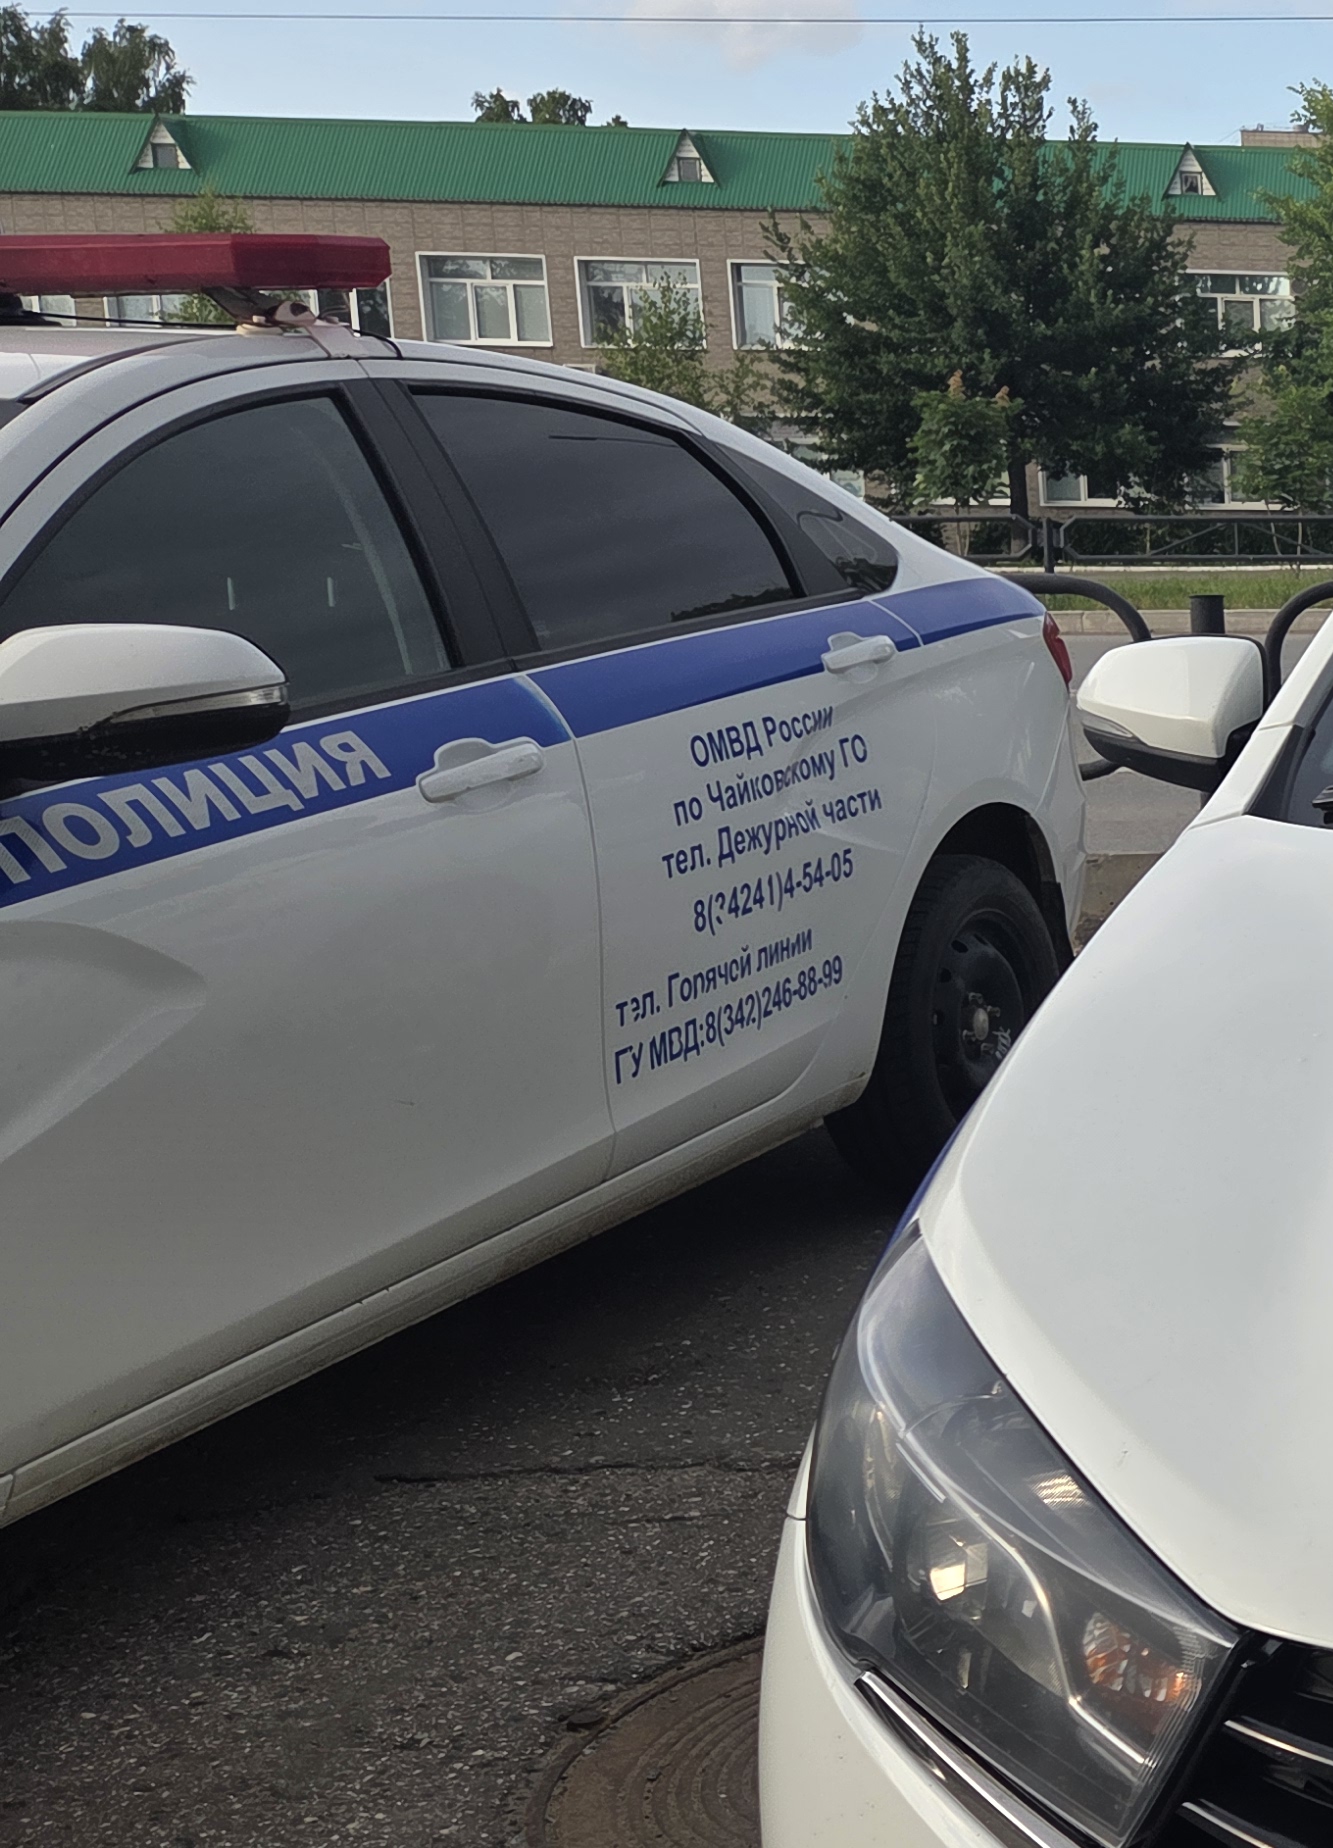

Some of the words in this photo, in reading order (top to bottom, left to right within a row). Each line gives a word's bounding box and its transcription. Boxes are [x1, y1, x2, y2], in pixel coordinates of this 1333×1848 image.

[673, 797, 702, 826] по
[706, 749, 835, 812] Чайковскому
[838, 734, 868, 768] ГО
[690, 720, 764, 767] ОМВД
[762, 706, 833, 747] России
[0, 730, 392, 884] ПОЛИЦИЯ
[661, 844, 711, 878] тел.
[717, 799, 821, 868] Дежурной
[822, 789, 882, 824] части
[694, 848, 853, 936] 8(34241)4-54-05
[615, 991, 660, 1027] тел.
[756, 928, 812, 972] линии
[614, 1042, 643, 1084] ГУ
